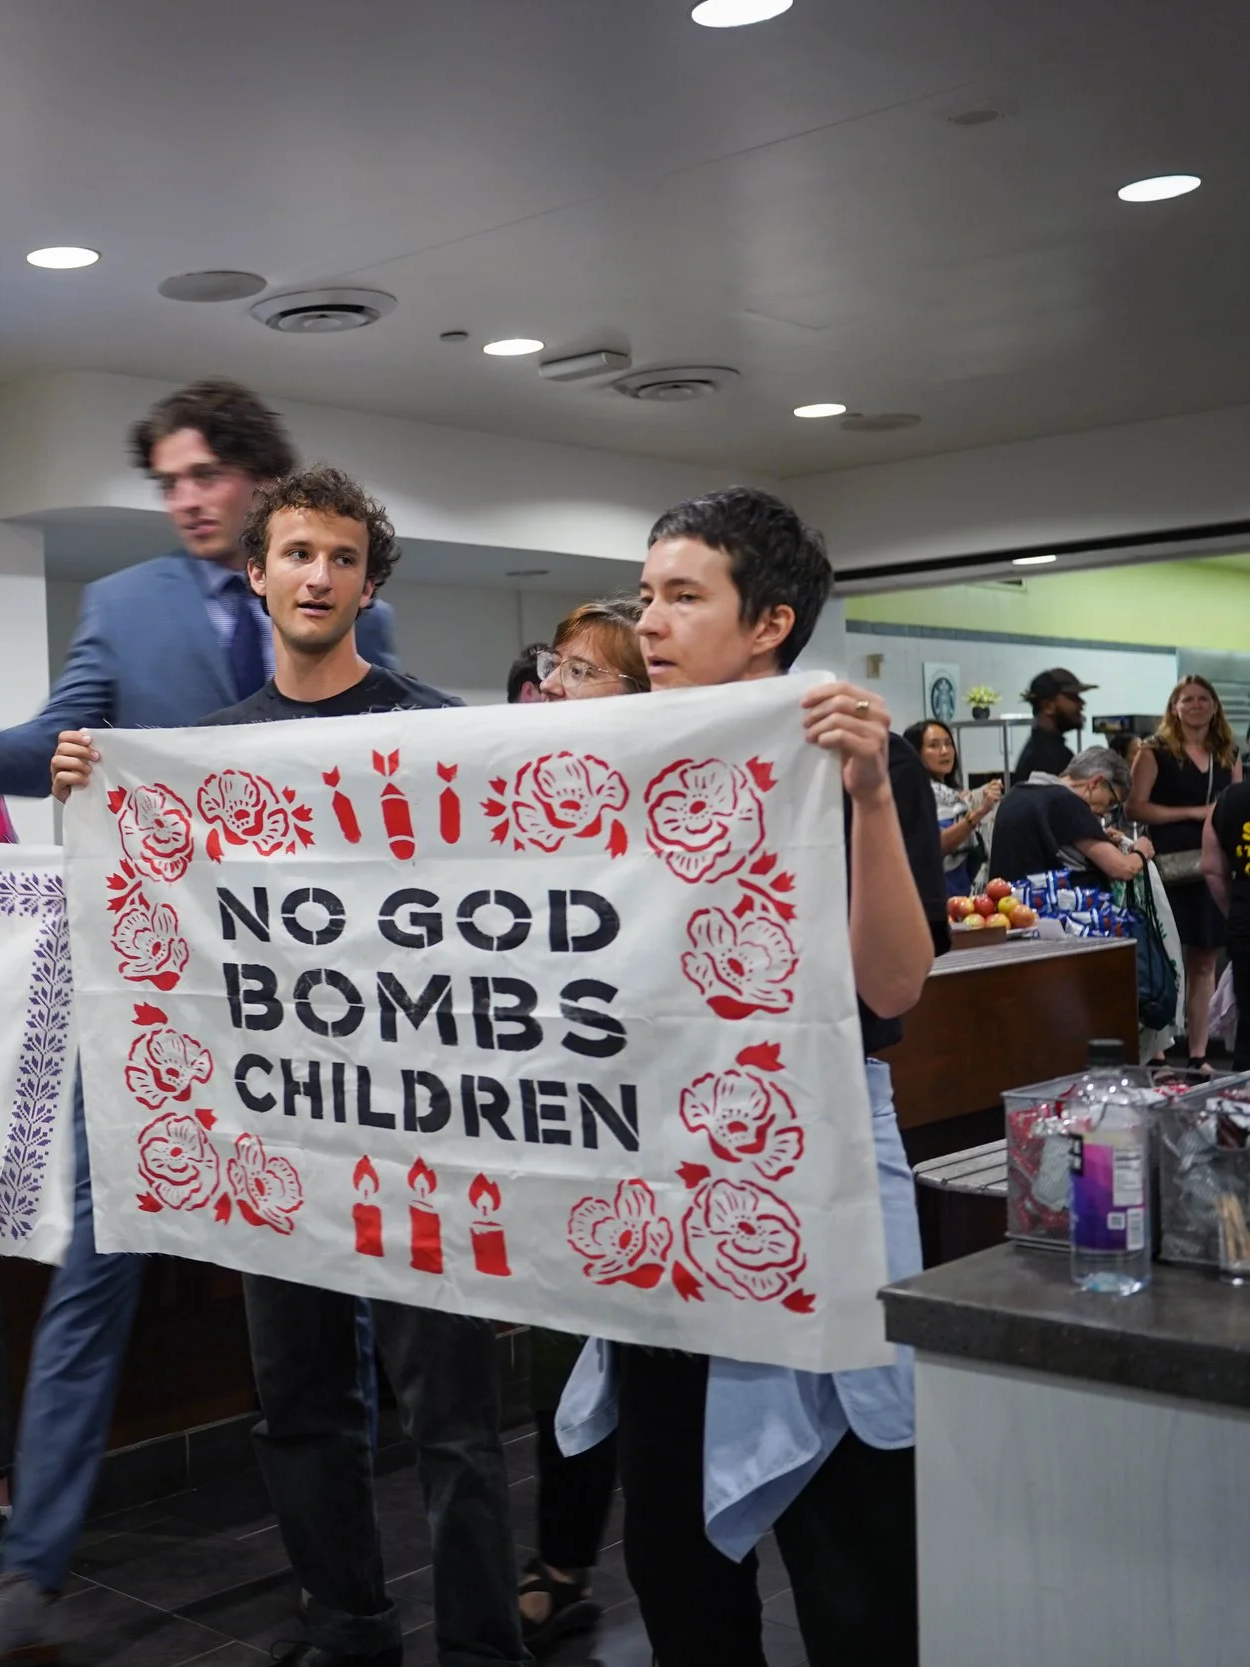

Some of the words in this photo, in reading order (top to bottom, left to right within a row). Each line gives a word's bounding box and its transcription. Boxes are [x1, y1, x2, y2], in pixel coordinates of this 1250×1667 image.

[216, 886, 346, 946] NO
[377, 887, 621, 952] GOD
[222, 962, 628, 1059] BOMBS
[234, 1053, 640, 1152] CHILDREN
